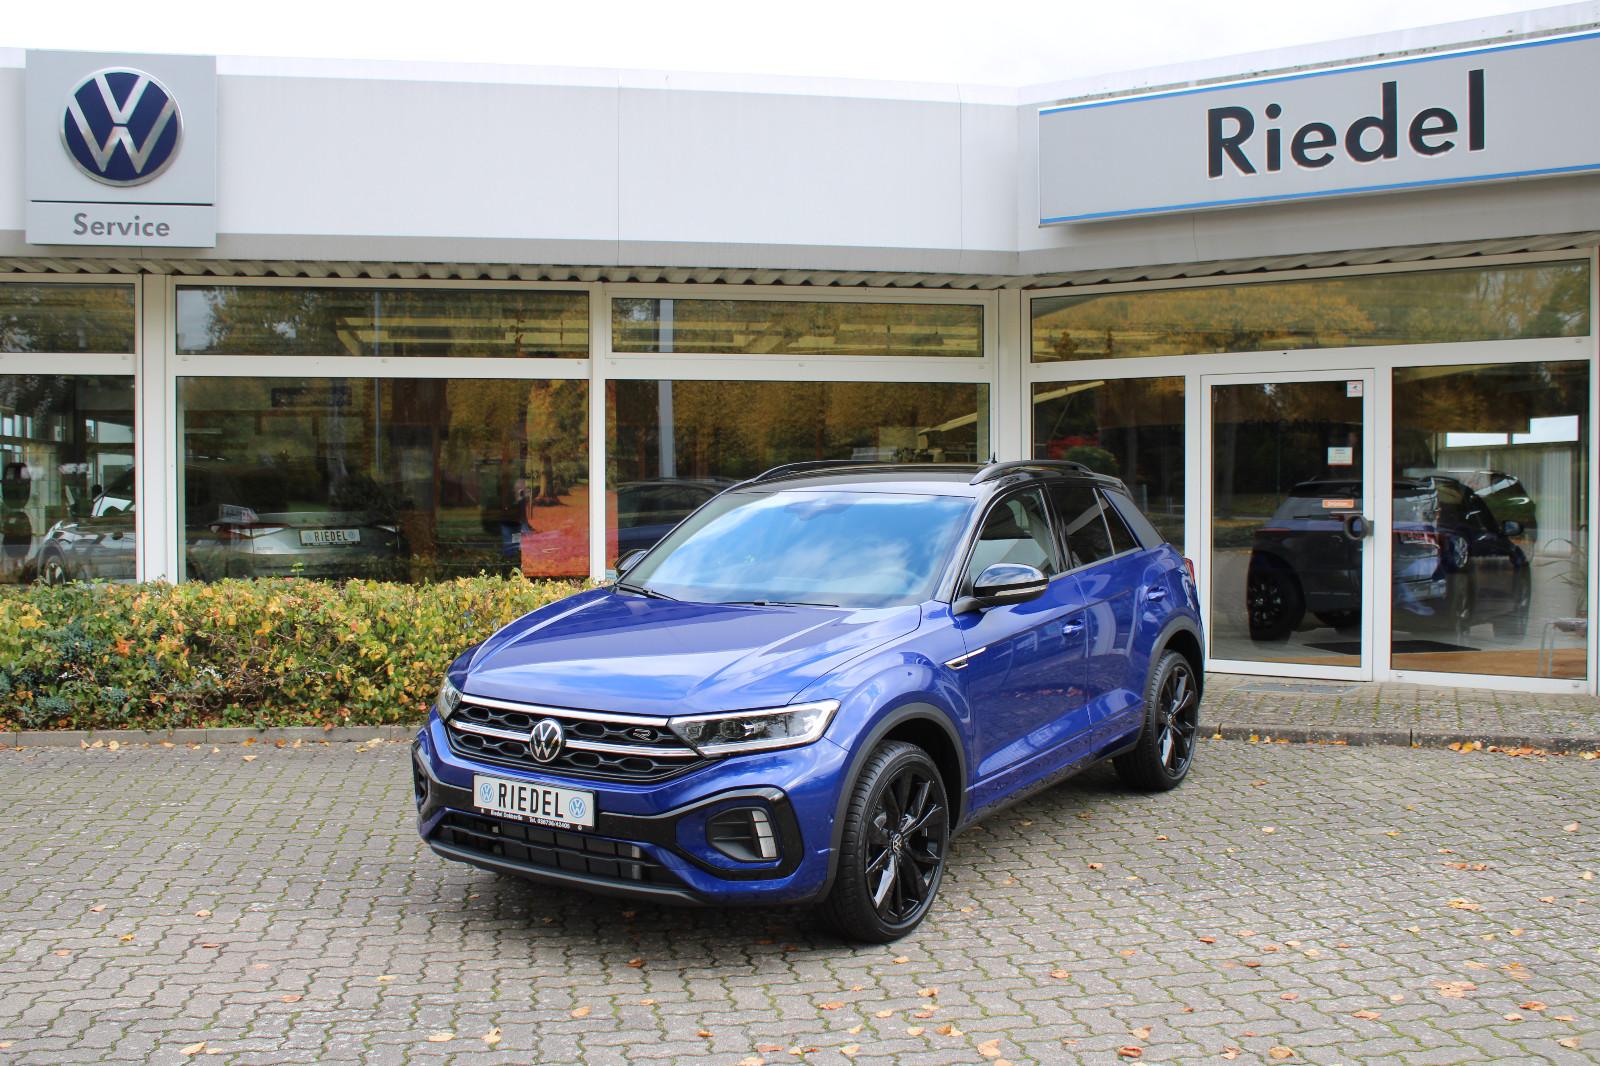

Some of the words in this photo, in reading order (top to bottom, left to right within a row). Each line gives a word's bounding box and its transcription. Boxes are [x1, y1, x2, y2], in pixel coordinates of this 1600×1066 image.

[1207, 69, 1485, 179] Riedel
[73, 212, 170, 237] Service
[314, 530, 348, 542] RIEDEL
[498, 782, 564, 818] RIEDEL
